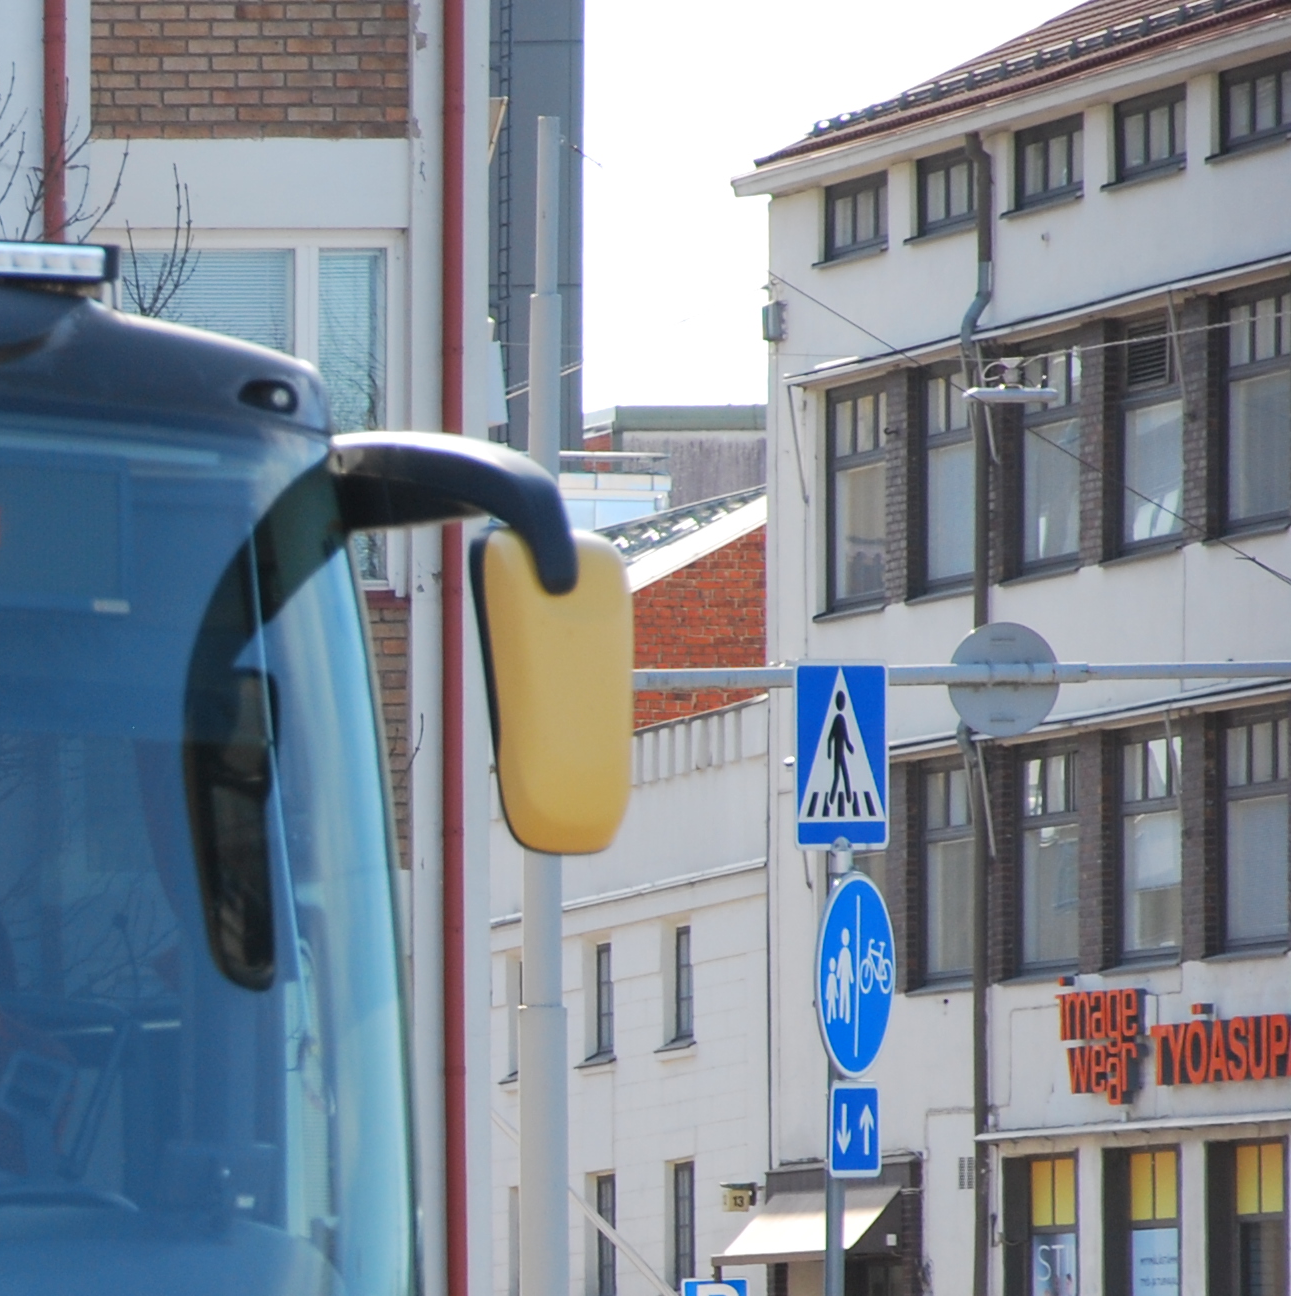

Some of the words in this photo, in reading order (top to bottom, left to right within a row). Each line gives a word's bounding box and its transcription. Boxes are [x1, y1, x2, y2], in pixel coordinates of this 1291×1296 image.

[1054, 976, 1139, 1054] image
[1150, 1002, 1291, 1086] TYÖASUP
[1067, 1041, 1138, 1105] wear
